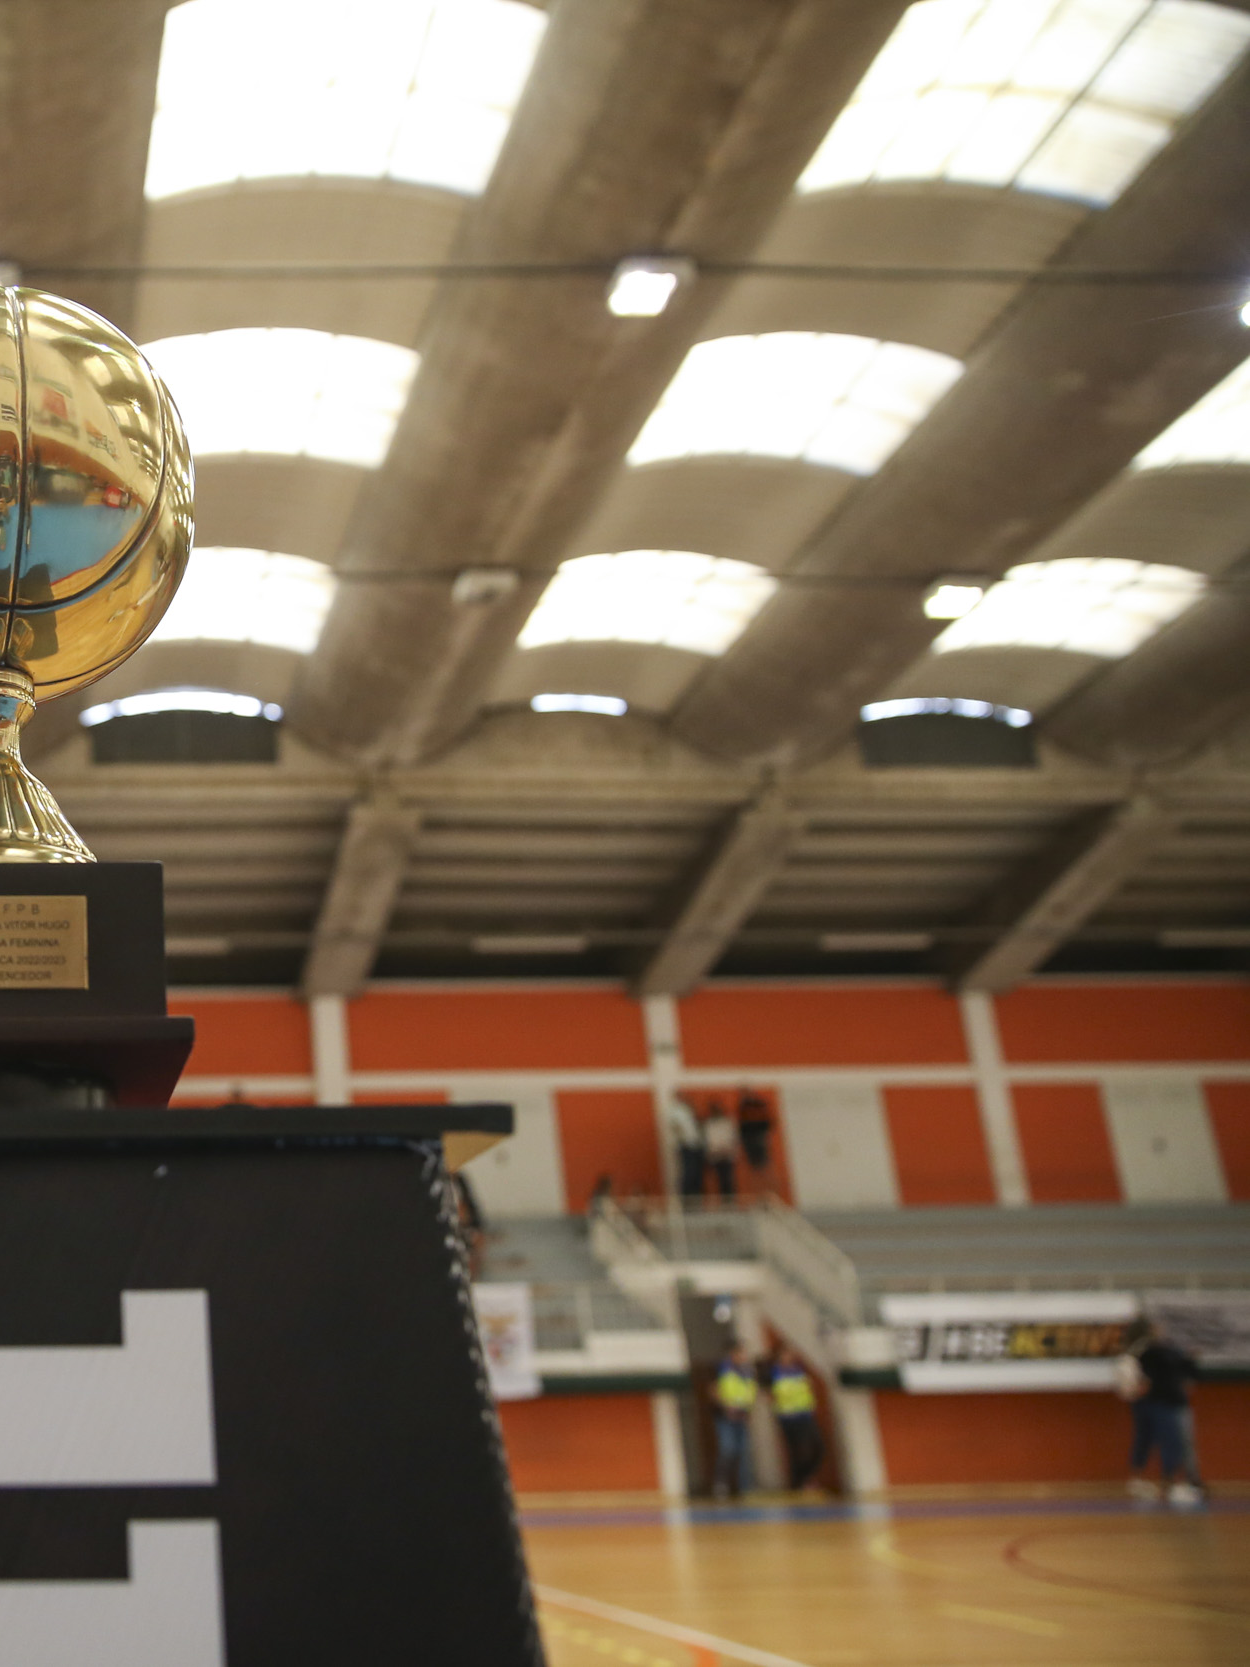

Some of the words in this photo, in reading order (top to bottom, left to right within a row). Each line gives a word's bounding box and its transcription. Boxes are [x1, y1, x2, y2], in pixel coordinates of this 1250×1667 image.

[3, 903, 11, 914] F
[16, 903, 26, 914] P
[31, 903, 40, 915] B
[38, 920, 70, 930] HUGO
[9, 938, 59, 948] FEMININA
[16, 954, 66, 965] 2022/2023
